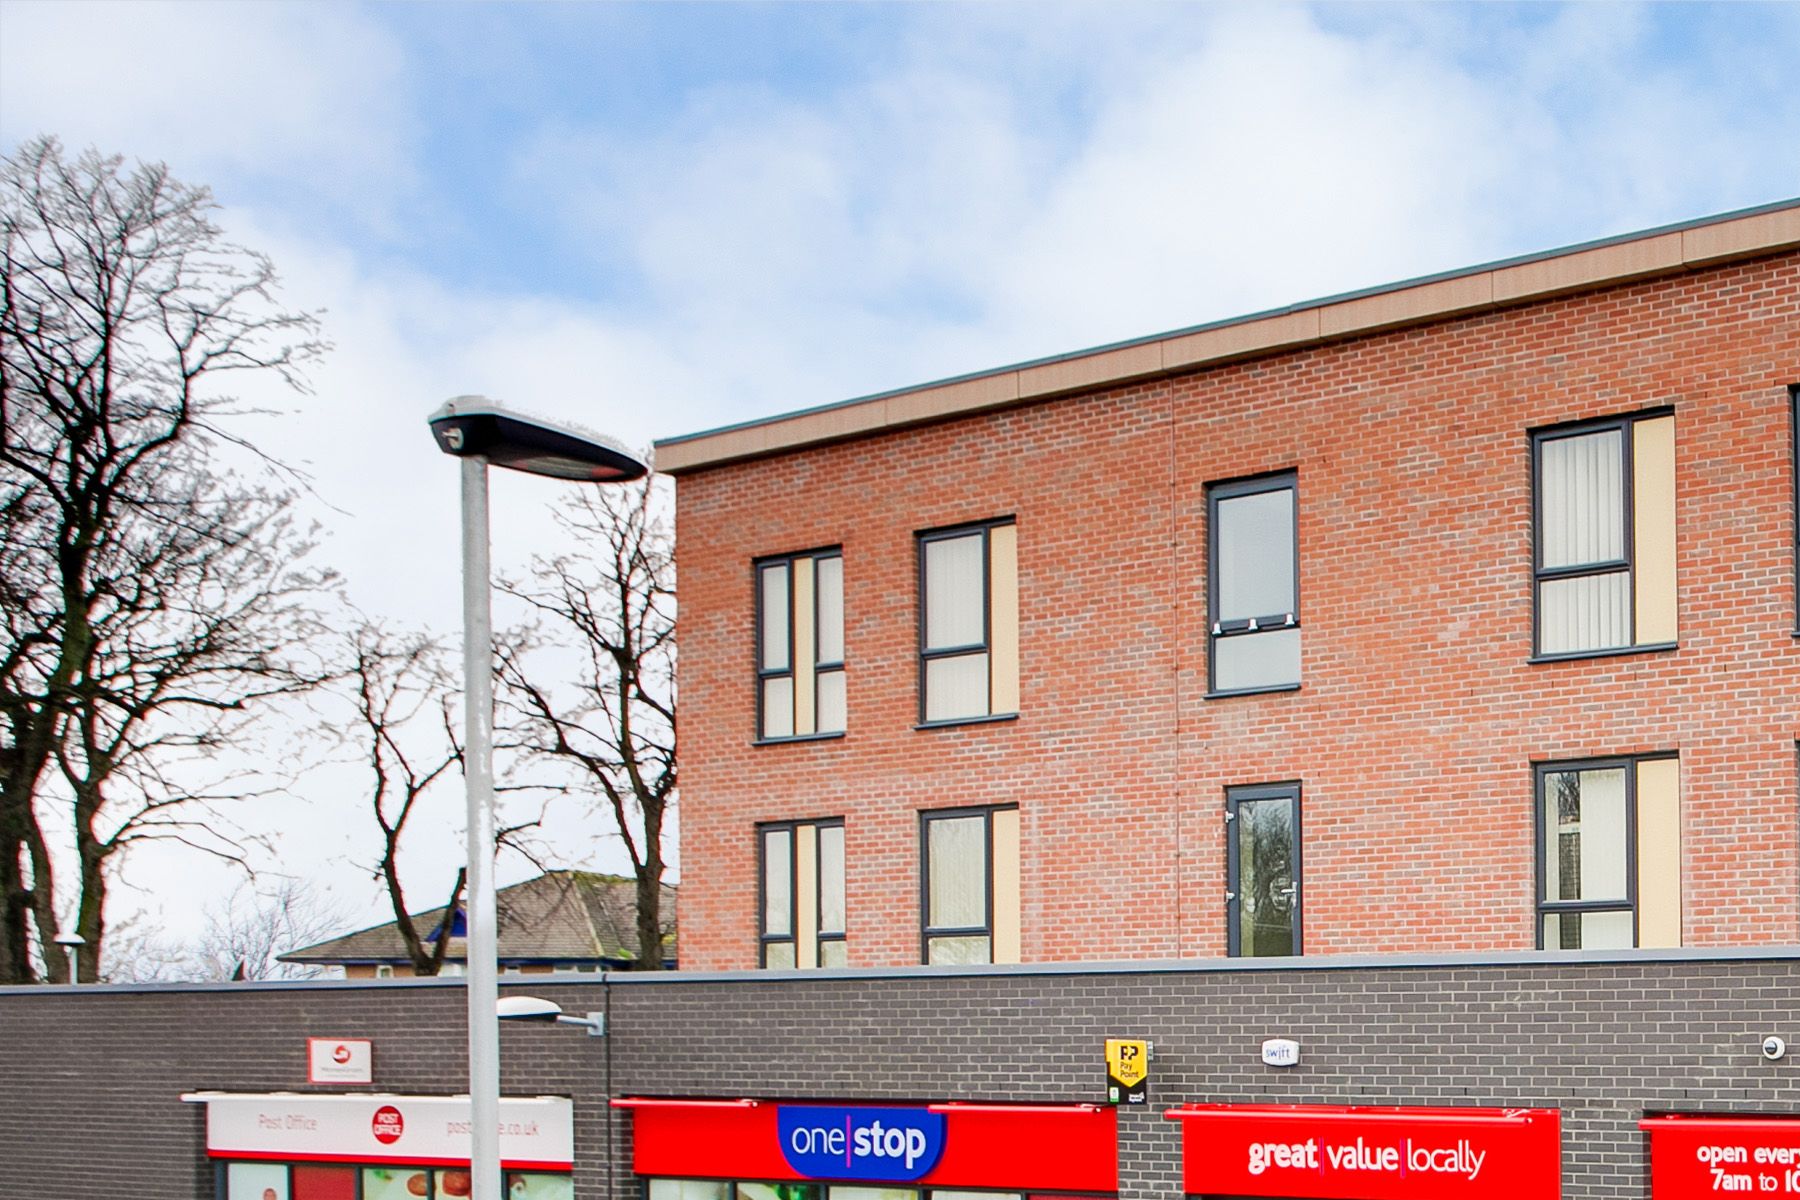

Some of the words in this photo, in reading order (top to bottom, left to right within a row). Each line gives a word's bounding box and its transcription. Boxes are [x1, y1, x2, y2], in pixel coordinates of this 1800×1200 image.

[1265, 1045, 1291, 1060] swift
[258, 1113, 283, 1130] Post
[286, 1114, 318, 1131] Office
[377, 1113, 399, 1124] POST
[373, 1124, 402, 1136] OFFICE
[791, 1127, 846, 1155] one
[853, 1120, 927, 1170] stop
[1248, 1138, 1318, 1176] great
[1326, 1136, 1399, 1171] value
[1407, 1138, 1487, 1181] locally
[1696, 1145, 1748, 1168] open
[1710, 1168, 1753, 1191] 7am
[1758, 1172, 1778, 1191] to
